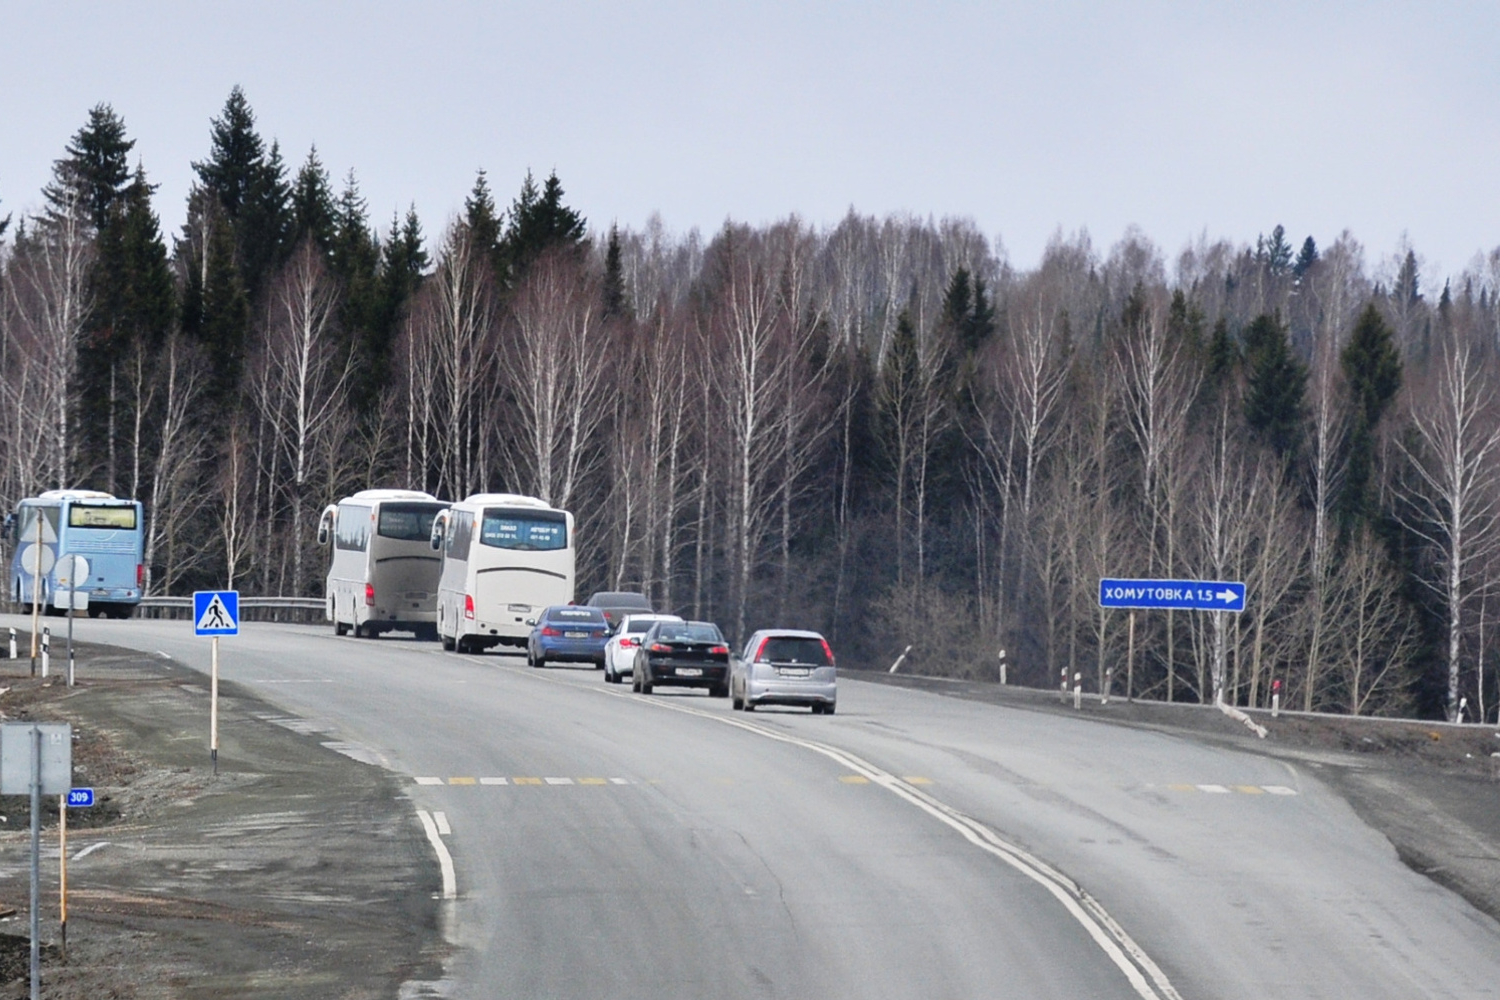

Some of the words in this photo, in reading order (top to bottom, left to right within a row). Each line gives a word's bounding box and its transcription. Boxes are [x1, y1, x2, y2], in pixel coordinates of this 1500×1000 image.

[1105, 587, 1194, 601] ХОМУТОВКА
[1197, 590, 1213, 602] 1.5
[70, 791, 88, 803] 309
